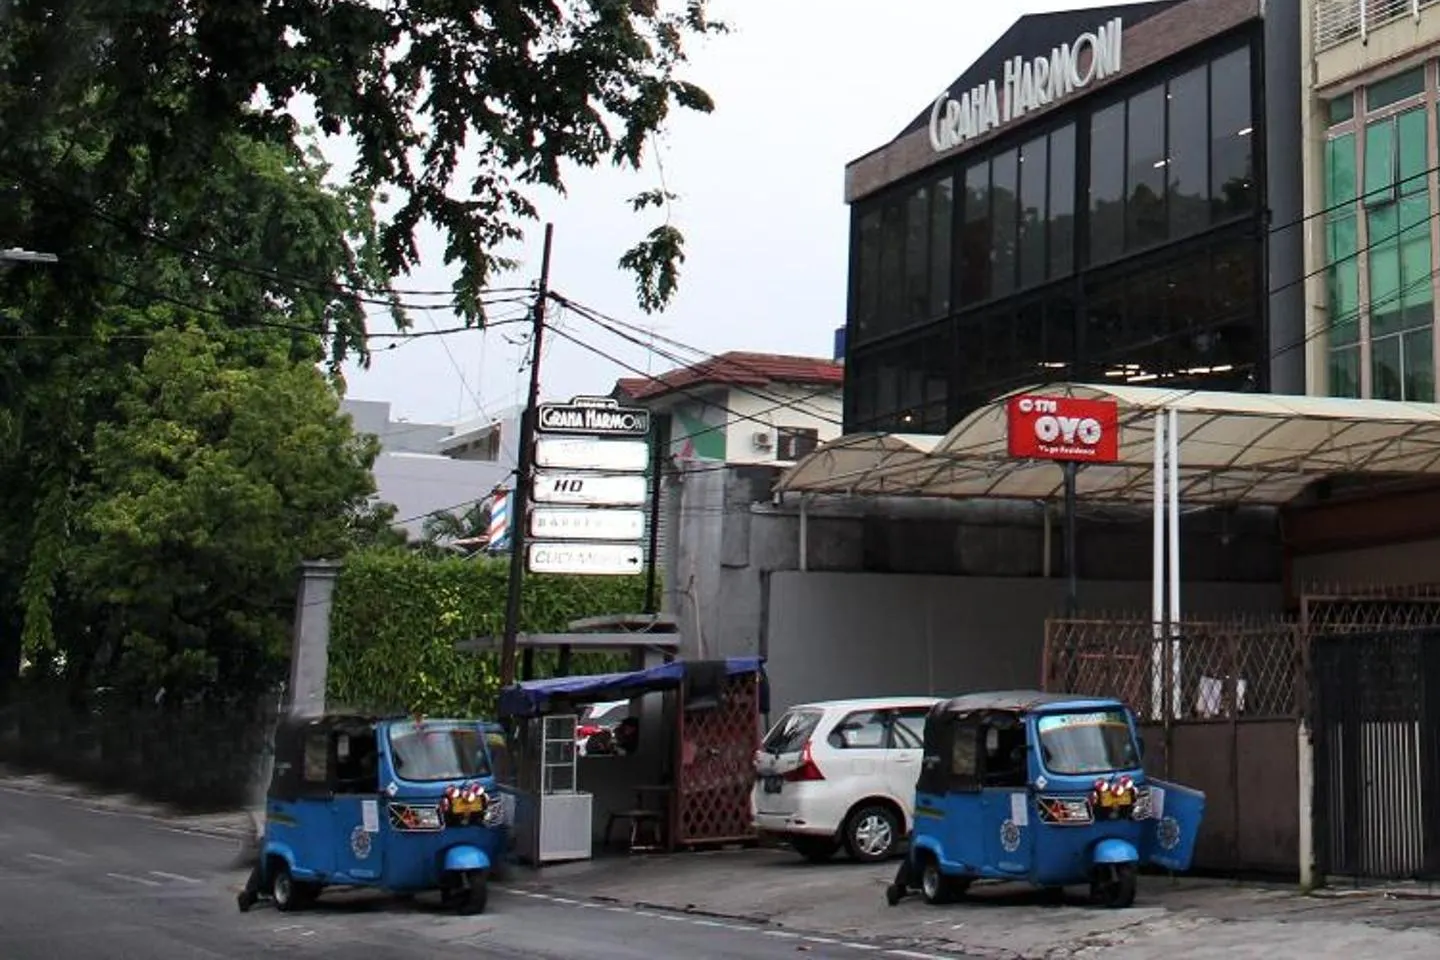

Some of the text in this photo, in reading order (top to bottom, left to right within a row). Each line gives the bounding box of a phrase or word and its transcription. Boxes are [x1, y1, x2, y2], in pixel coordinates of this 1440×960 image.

[929, 17, 1122, 152] GRAHA HARMONI
[1034, 415, 1102, 445] OYO
